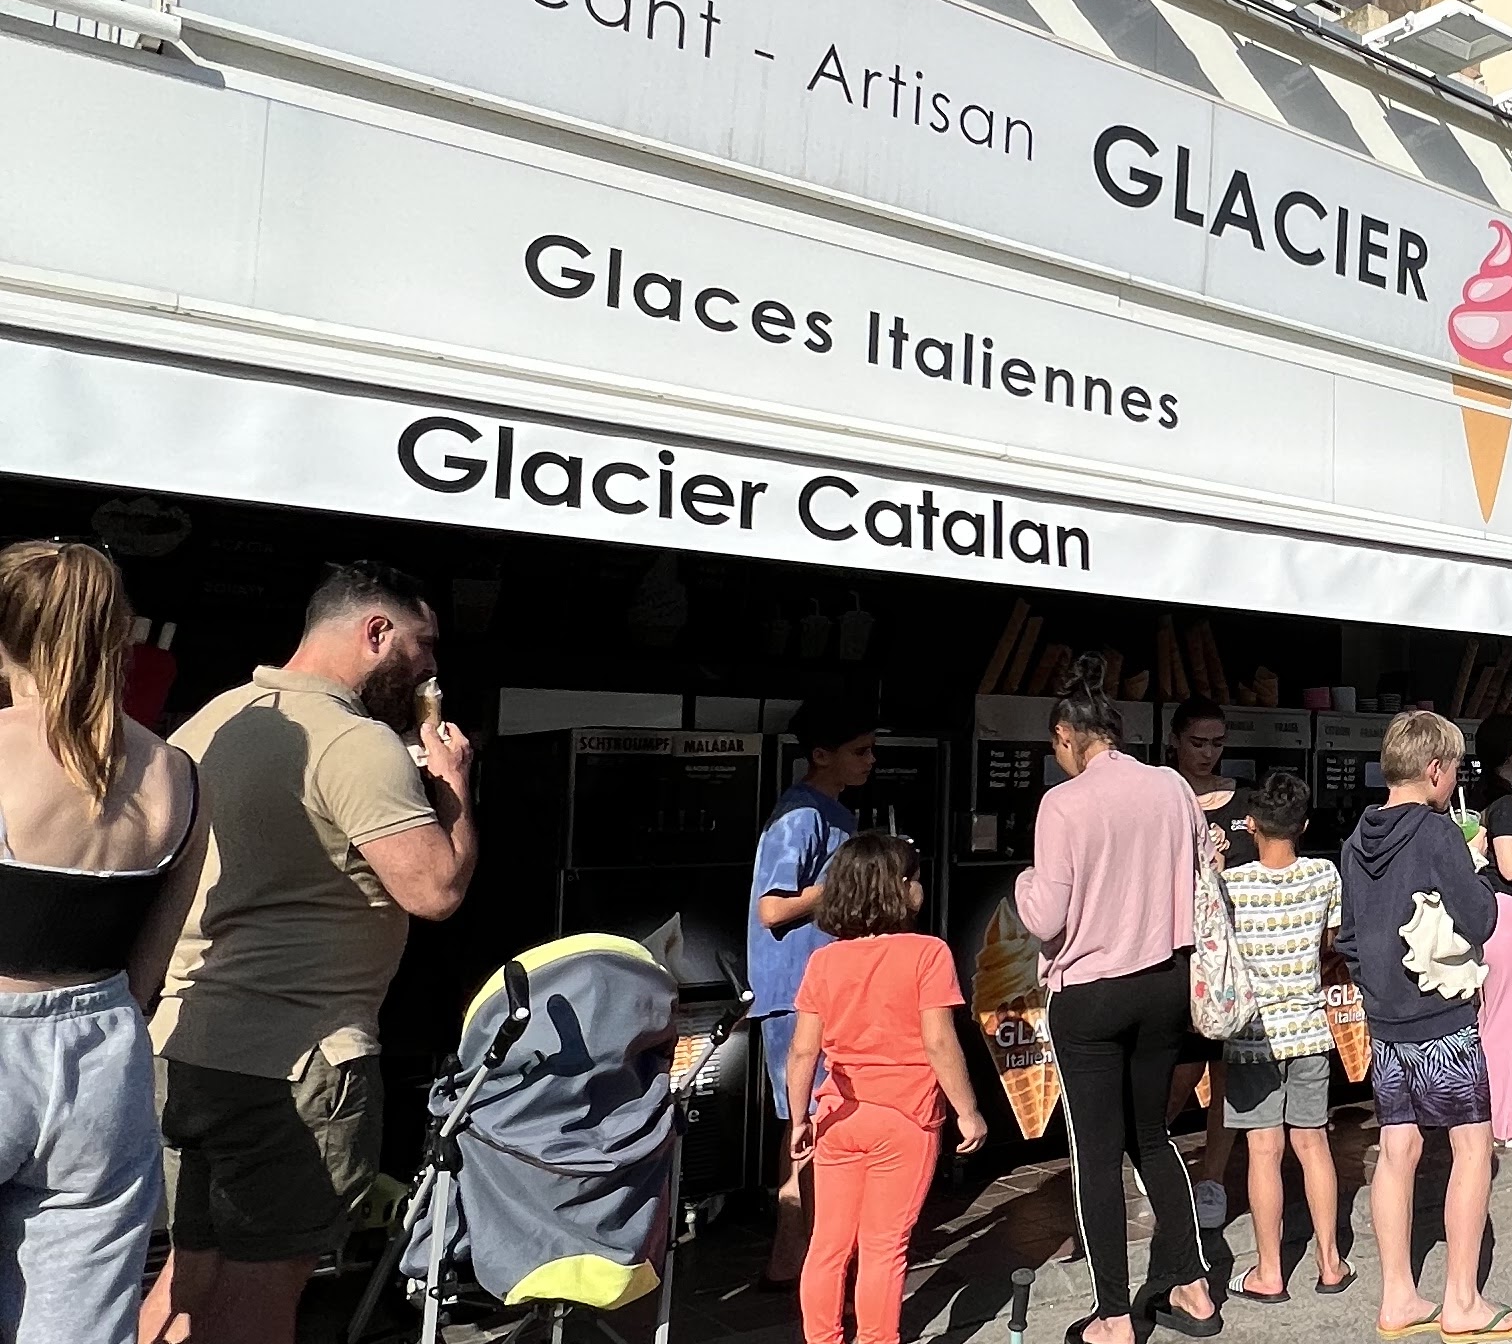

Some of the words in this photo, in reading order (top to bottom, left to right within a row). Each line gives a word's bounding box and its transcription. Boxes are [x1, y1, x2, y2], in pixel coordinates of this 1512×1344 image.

[754, 49, 775, 61] -
[806, 43, 1033, 161] Artisan
[1093, 125, 1428, 302] GLACIER
[524, 234, 833, 354] Glaces
[868, 310, 1179, 430] Italiennes
[398, 416, 768, 530] Glacier
[798, 475, 1091, 571] Catalan
[580, 736, 670, 752] SCHTROUMPF
[684, 738, 744, 753] MALABAR
[996, 1019, 1050, 1047] GLA
[1328, 984, 1364, 1007] GLA
